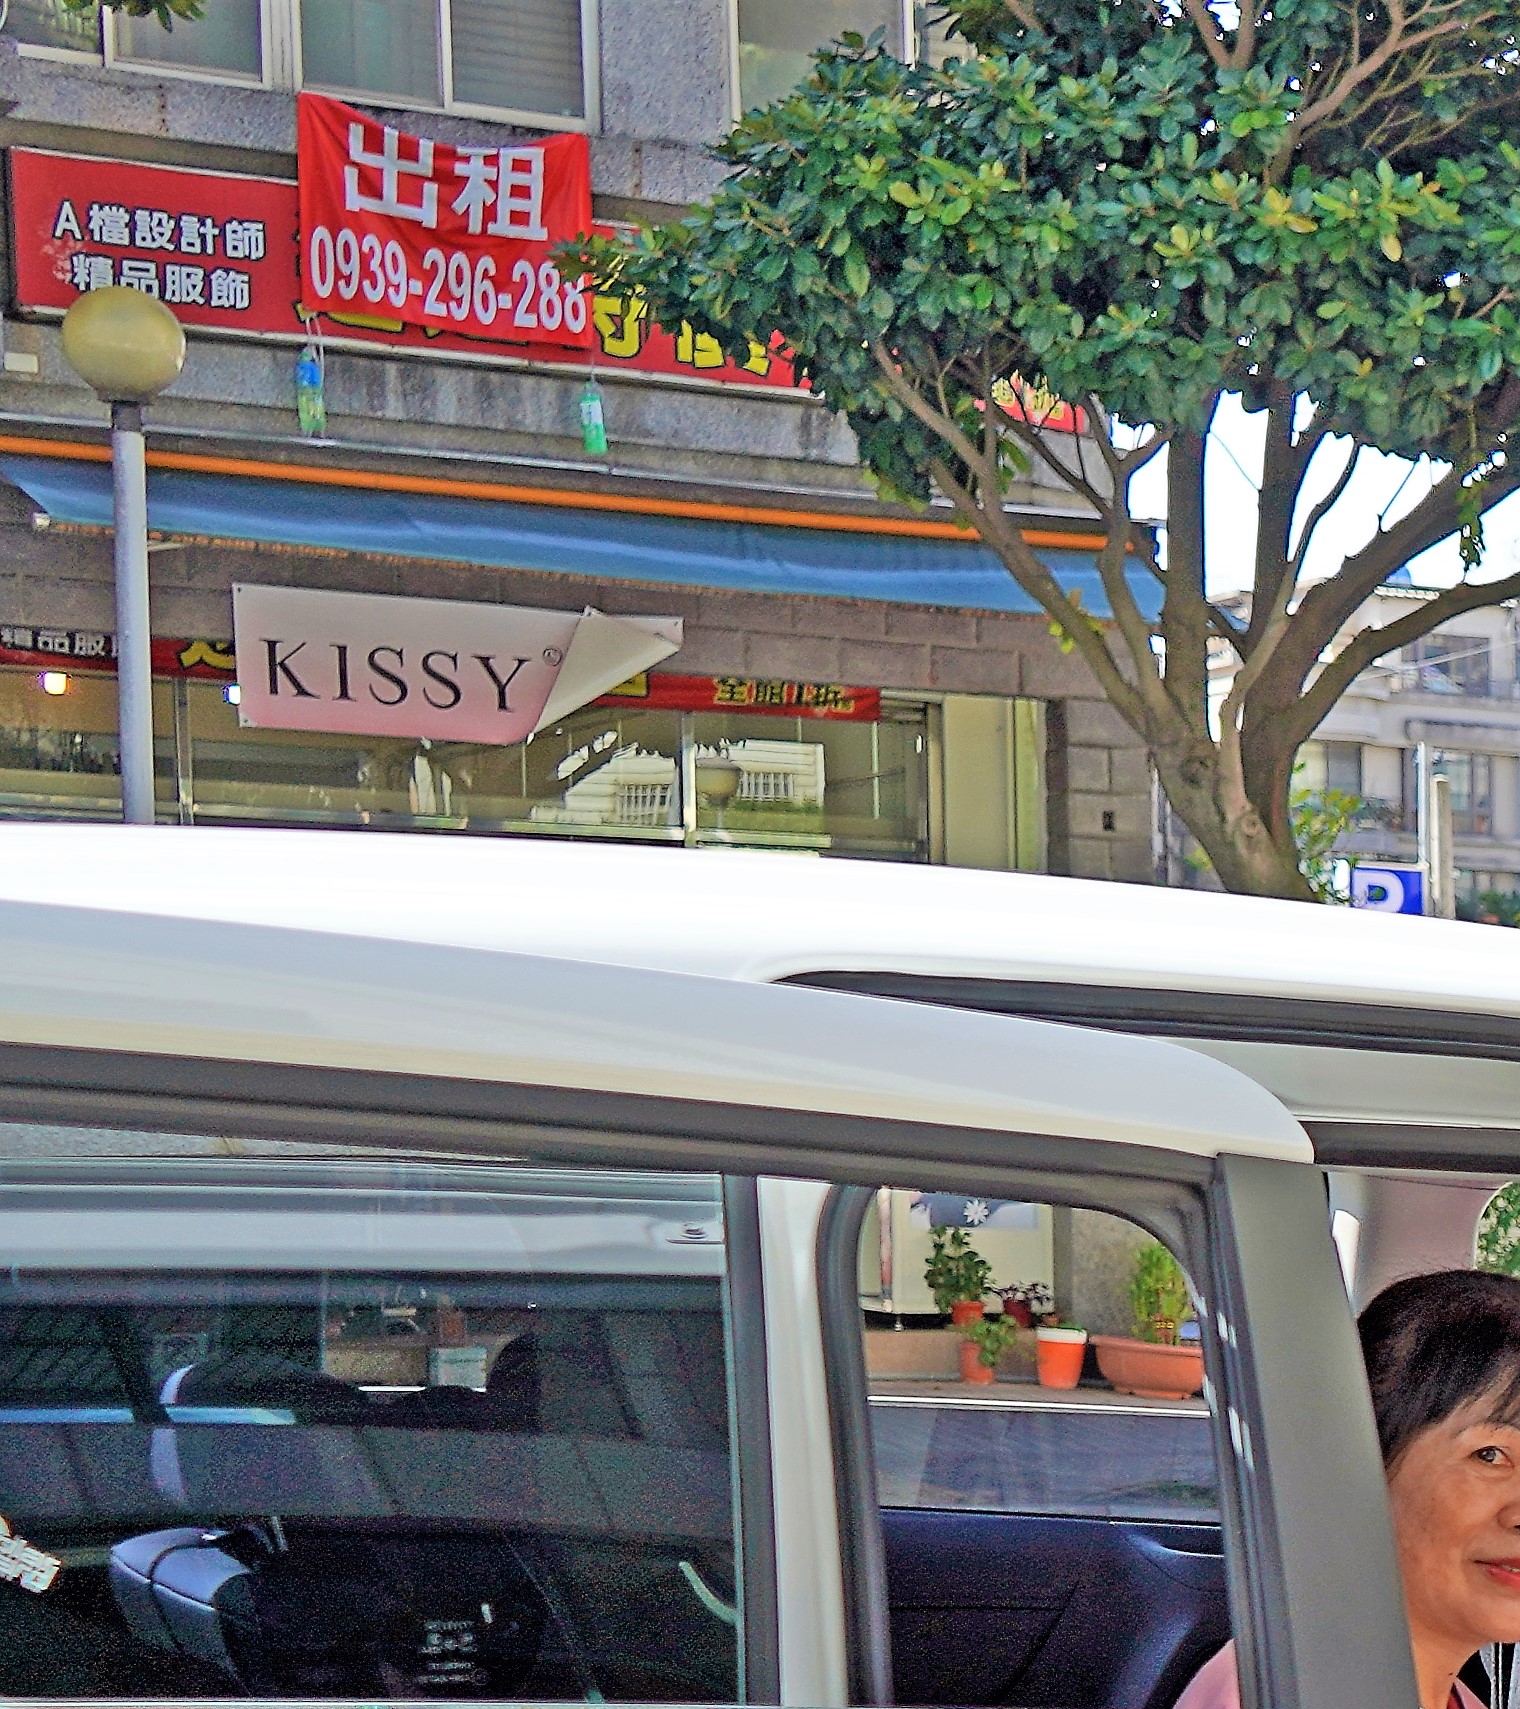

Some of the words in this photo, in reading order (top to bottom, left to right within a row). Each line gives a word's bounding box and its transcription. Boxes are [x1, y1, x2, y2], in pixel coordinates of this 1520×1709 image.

[344, 122, 548, 241] 出租
[54, 199, 266, 261] A檔設計師
[70, 253, 250, 310] 精品服飾
[310, 225, 588, 334] 0939-296-288
